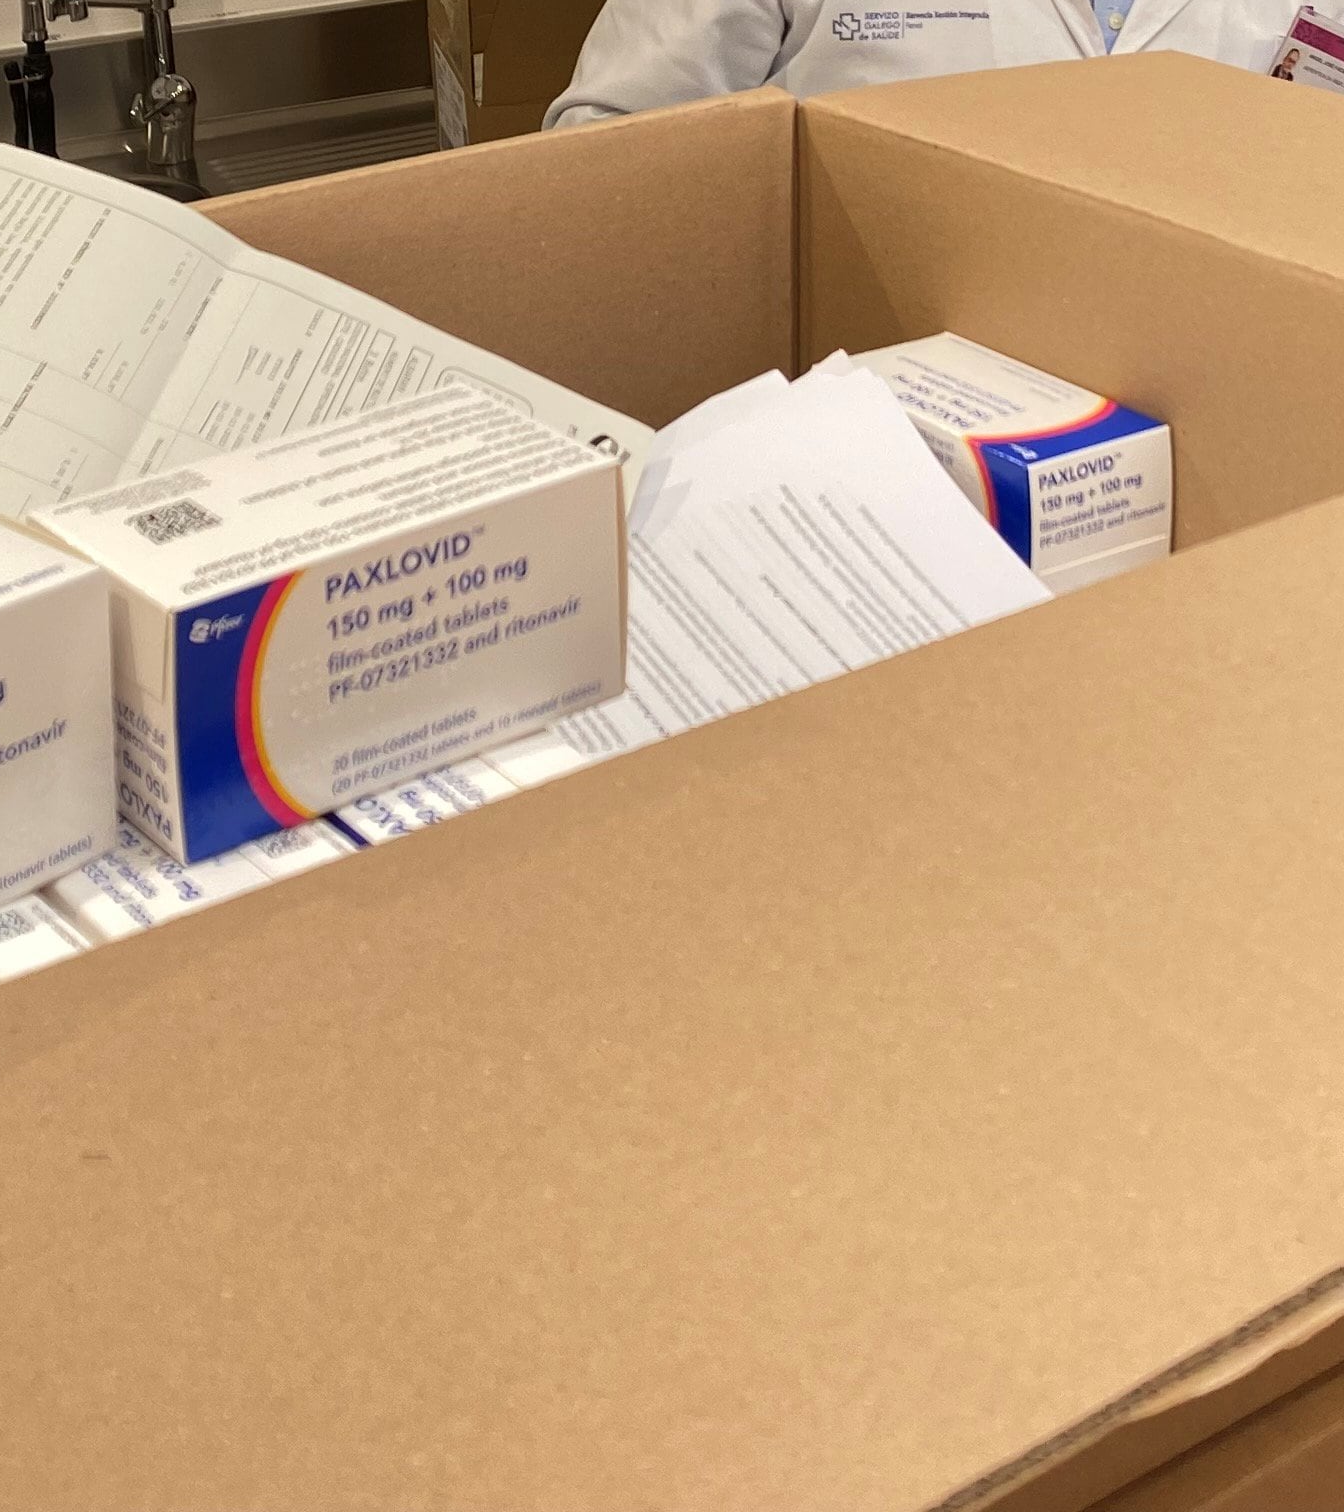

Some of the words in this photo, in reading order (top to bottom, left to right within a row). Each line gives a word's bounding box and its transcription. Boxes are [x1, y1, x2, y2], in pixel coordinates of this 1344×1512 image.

[1039, 455, 1113, 492] PAXLOVID
[327, 606, 369, 640] 150
[378, 596, 413, 623] mg
[447, 566, 486, 599] 100
[494, 556, 528, 582] mg
[444, 596, 509, 634] tablets
[464, 622, 499, 654] and
[120, 783, 172, 840] PAXLO
